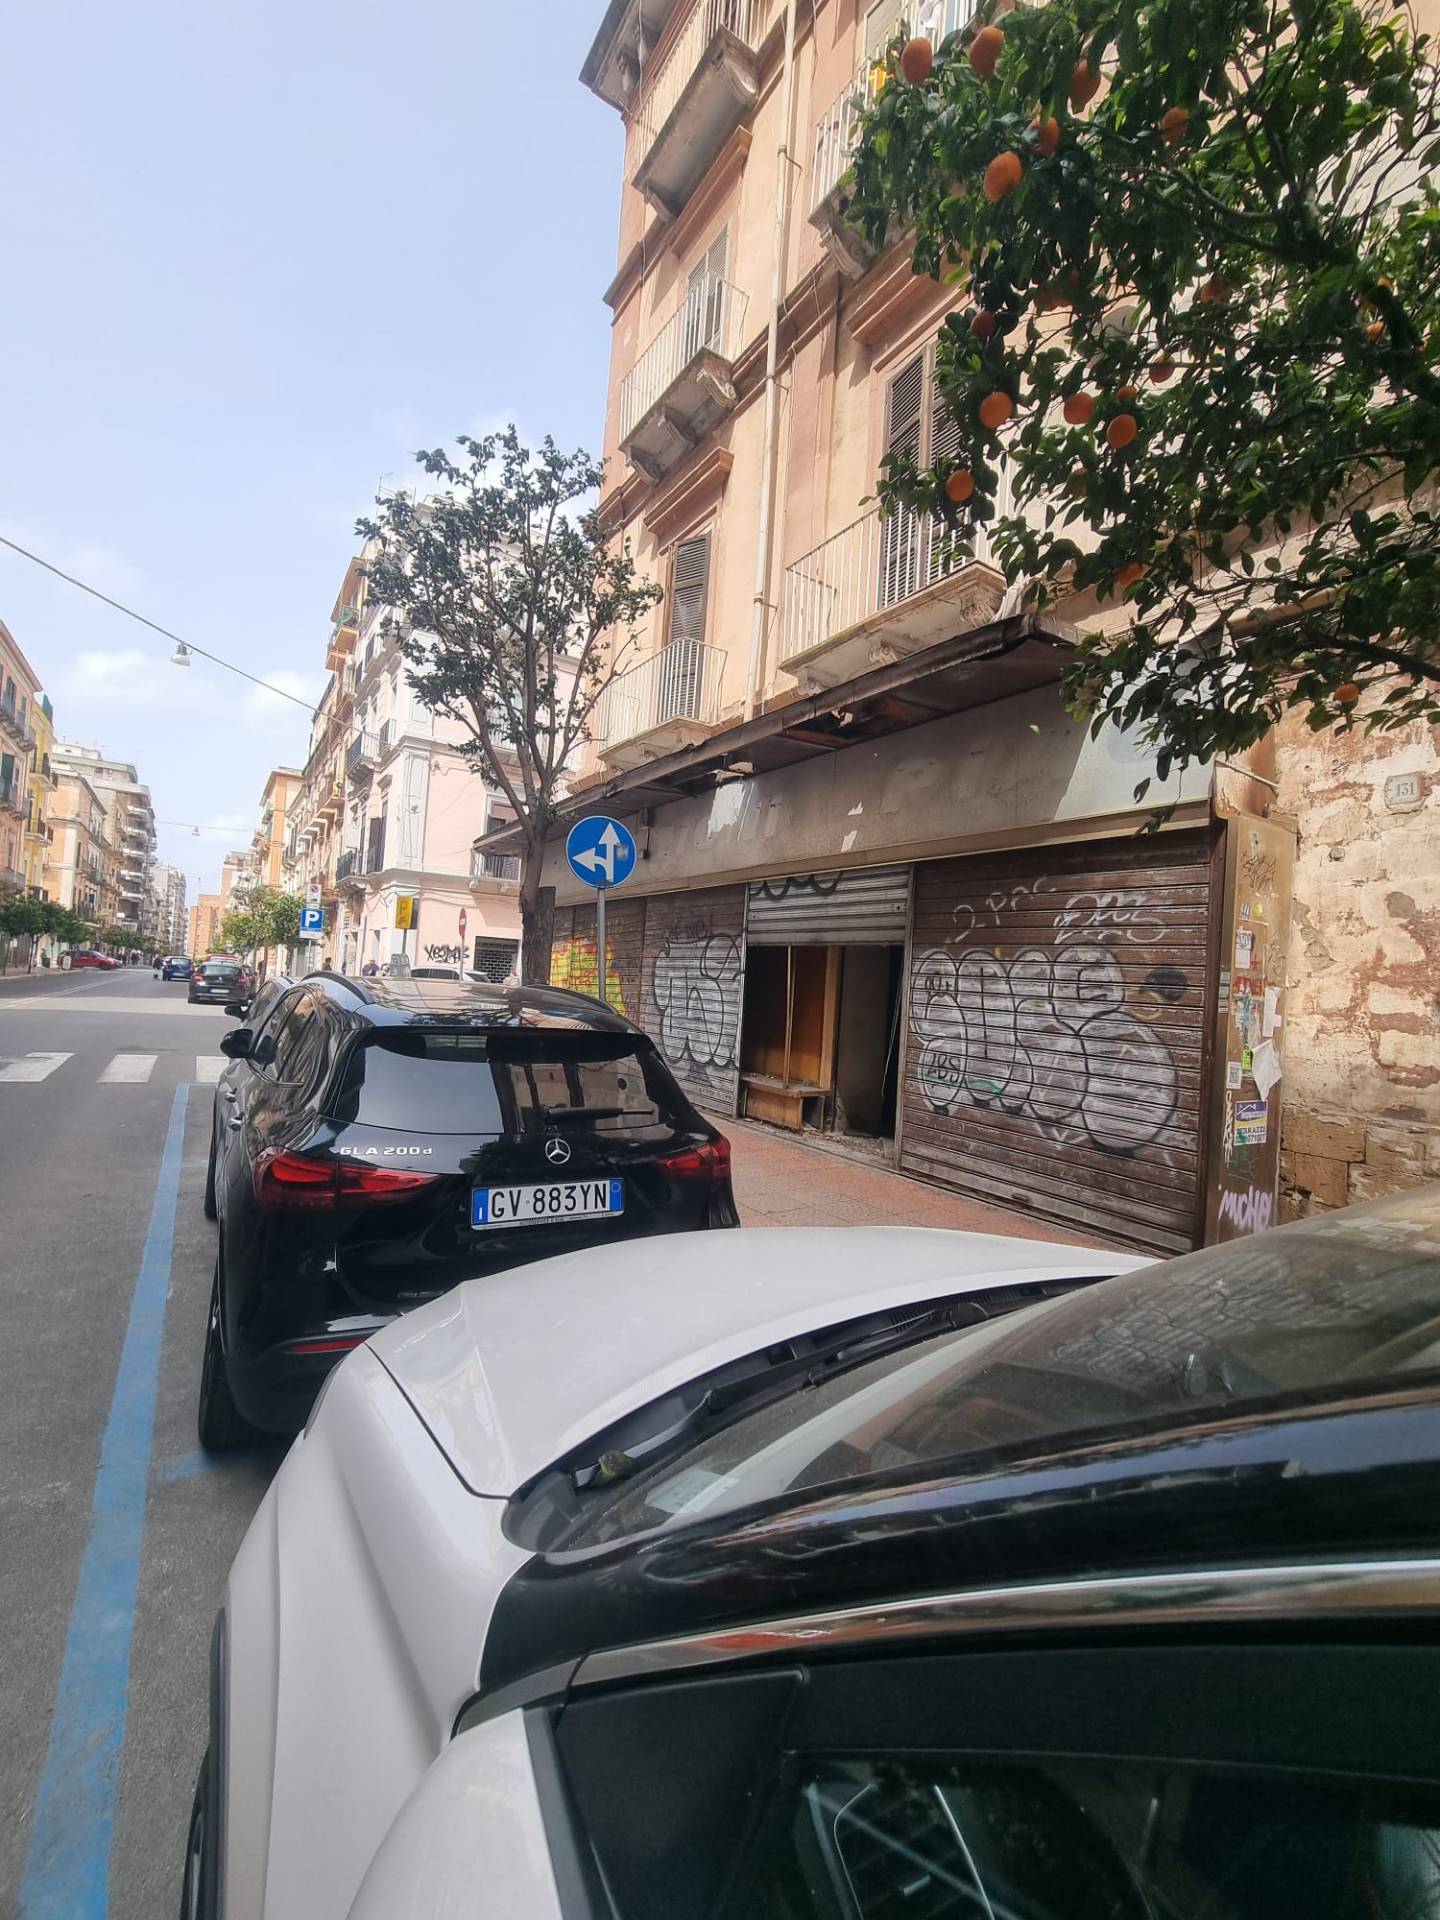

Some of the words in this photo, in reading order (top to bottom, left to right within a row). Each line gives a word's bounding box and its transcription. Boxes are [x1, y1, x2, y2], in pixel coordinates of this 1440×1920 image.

[304, 910, 320, 927] P
[340, 1147, 378, 1156] GLA
[491, 1189, 522, 1218] GV
[532, 1183, 607, 1214] 883YN
